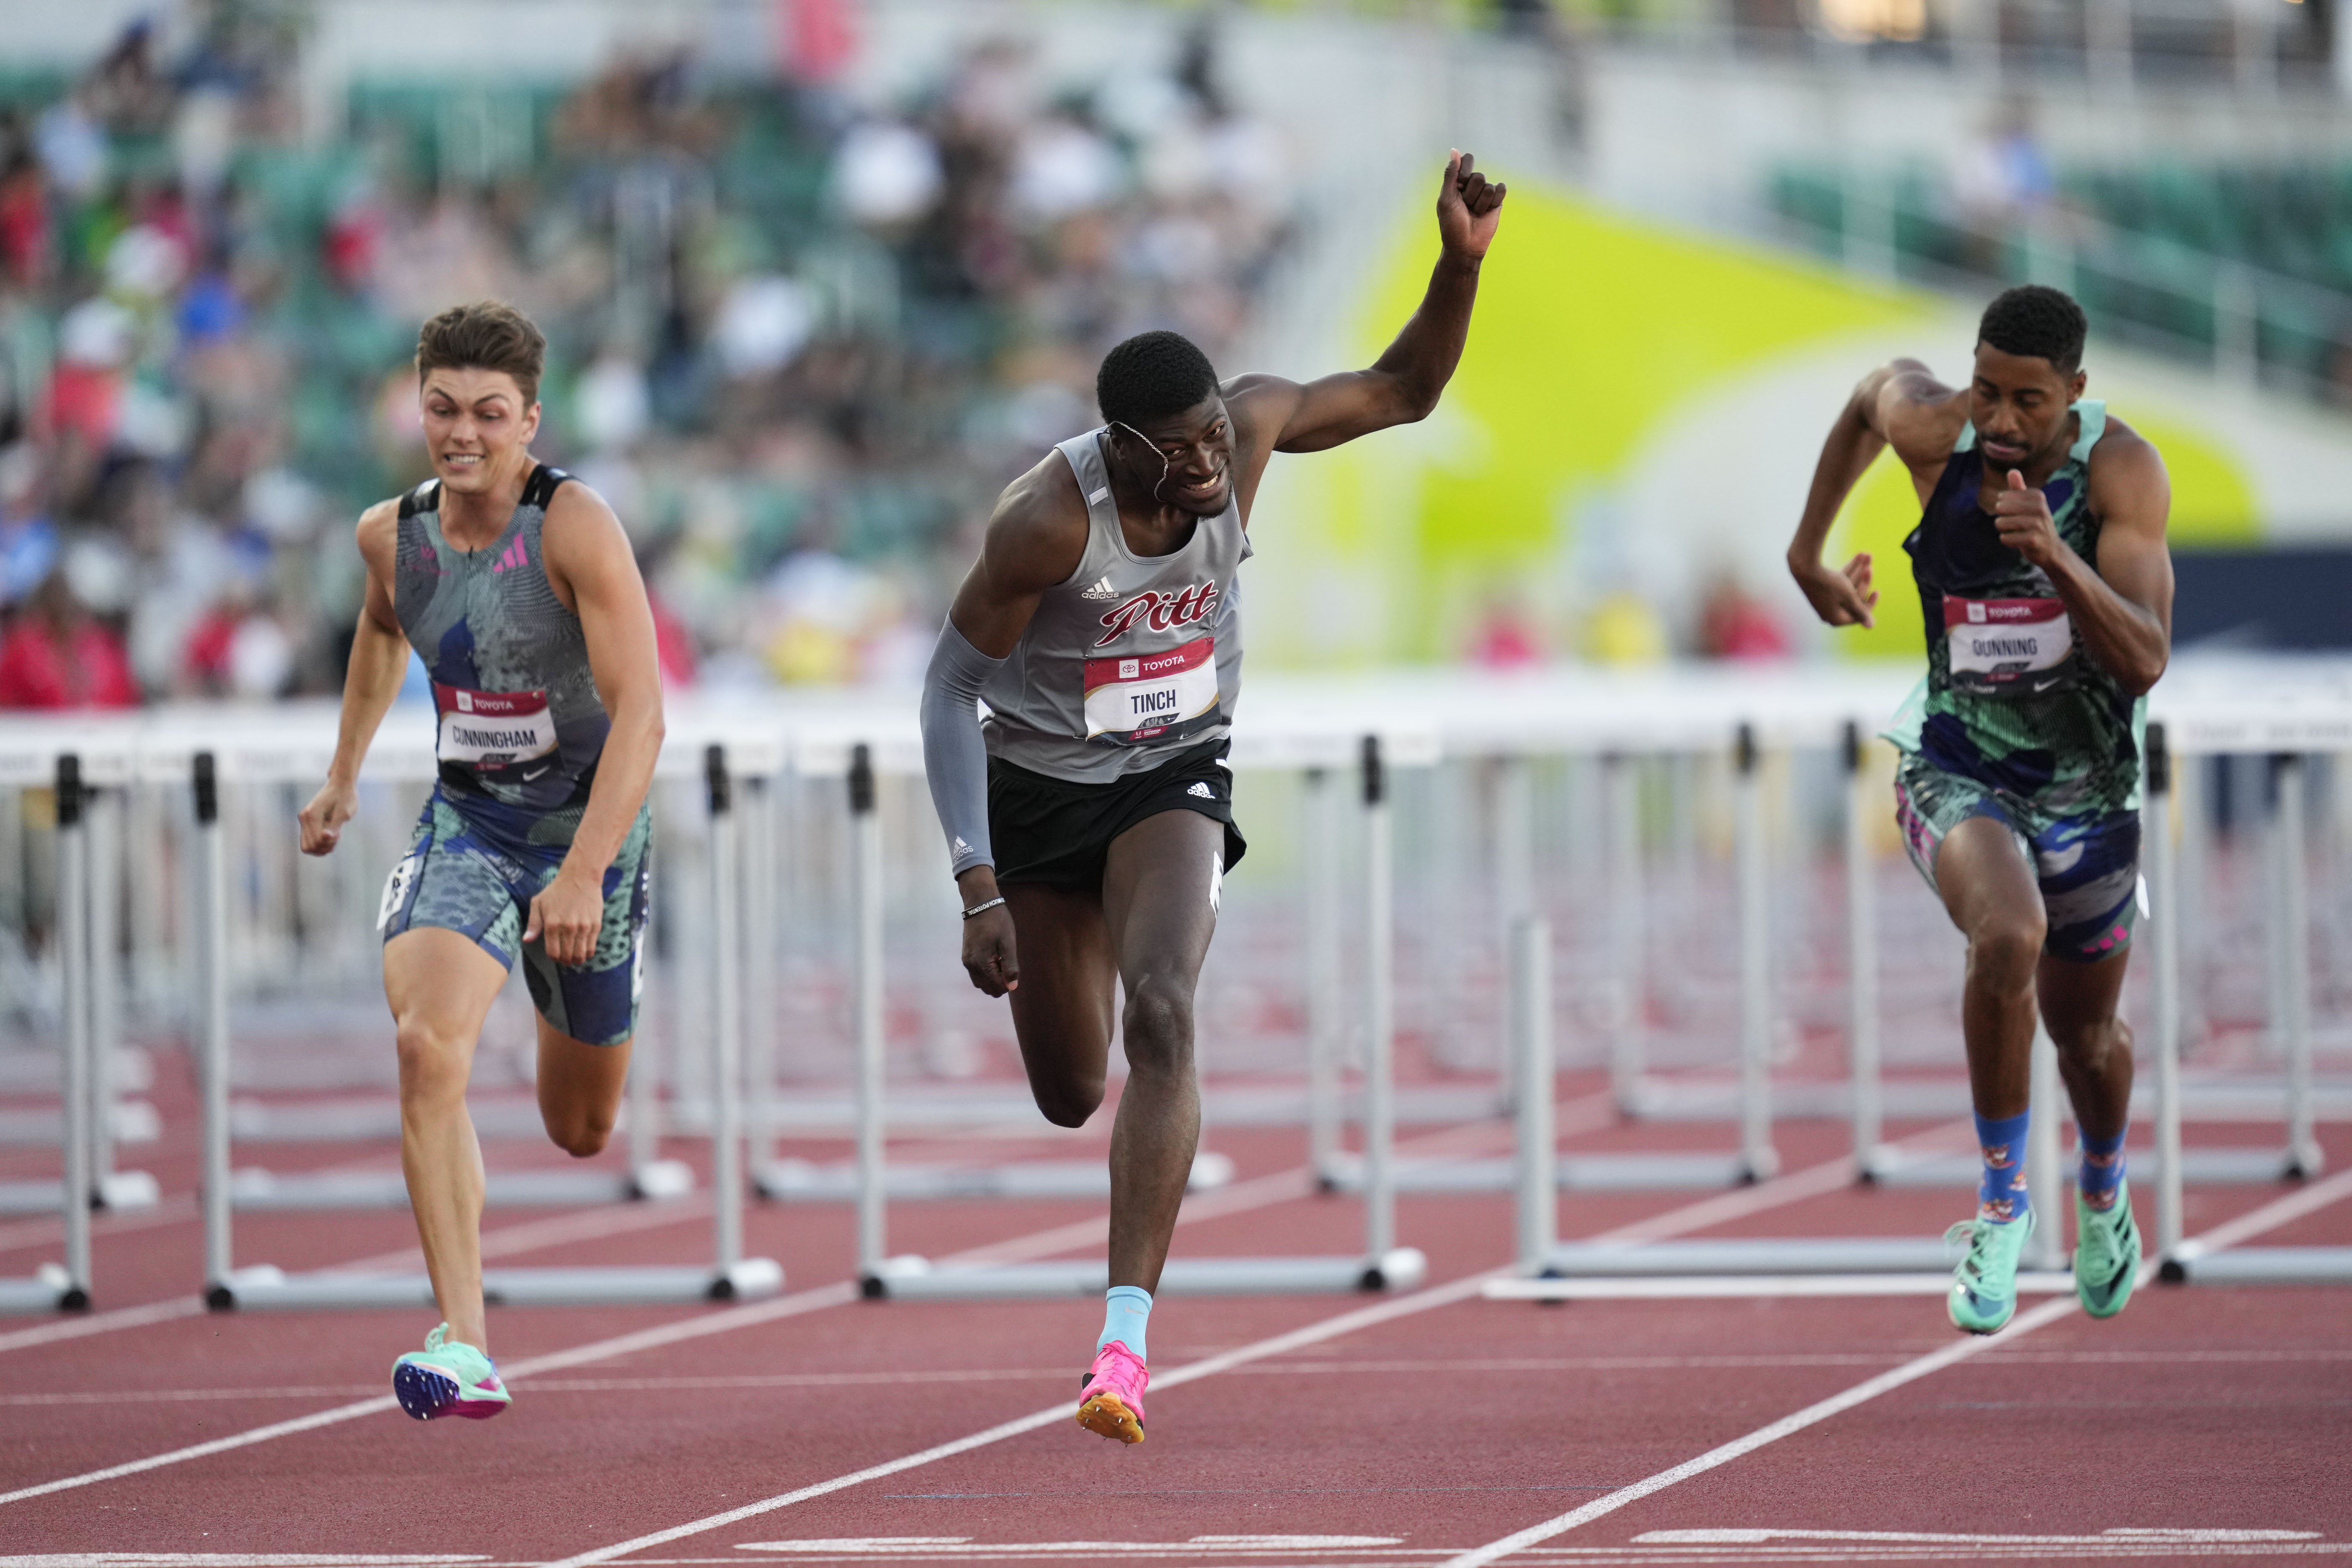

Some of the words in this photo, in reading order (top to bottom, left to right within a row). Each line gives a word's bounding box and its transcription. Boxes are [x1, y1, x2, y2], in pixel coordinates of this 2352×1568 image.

[1081, 591, 1120, 600] adidas
[1094, 579, 1219, 647] Pitt
[1988, 606, 2032, 618] TOYOTA
[1143, 655, 1185, 671] TOYOTA
[474, 699, 515, 711] TOYOTA
[1131, 689, 1176, 714] TINCH
[452, 725, 537, 748] CUNNINGHAM
[967, 902, 990, 916] POTENTIAL
